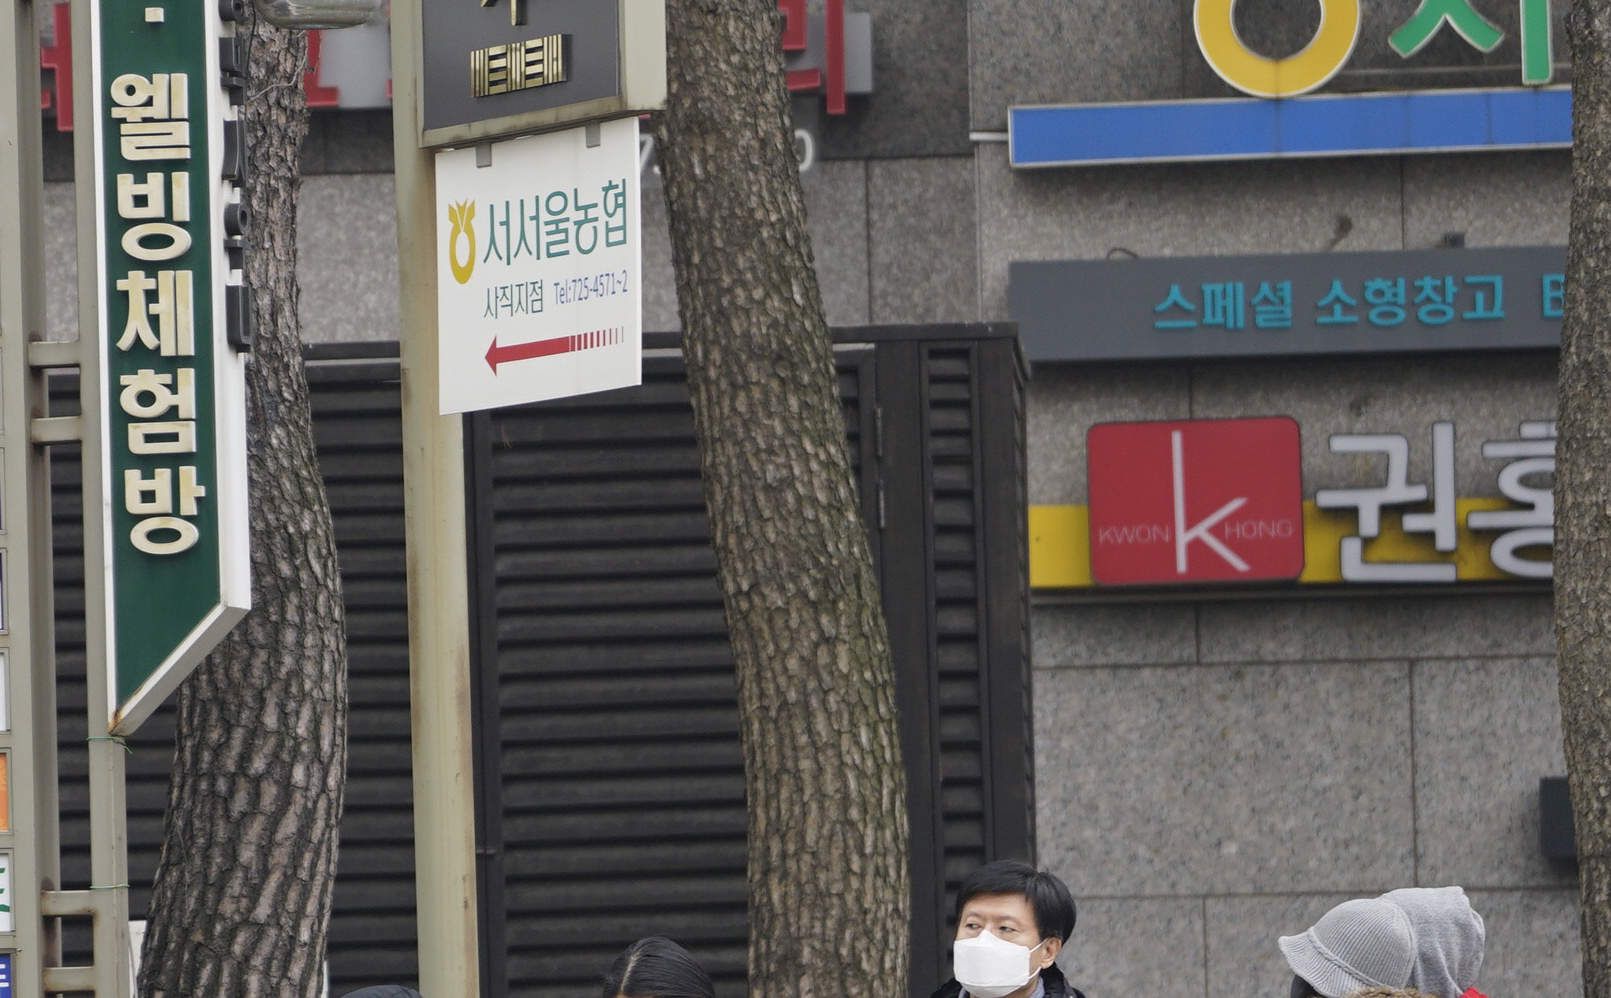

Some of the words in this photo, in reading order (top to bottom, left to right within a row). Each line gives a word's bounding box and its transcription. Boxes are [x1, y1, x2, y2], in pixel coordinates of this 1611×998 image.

[483, 178, 627, 266] 서서울농협
[109, 73, 207, 555] 웰빙체험방
[483, 279, 544, 319] 사직지점
[1153, 280, 1293, 330] 스페셜
[1316, 274, 1505, 326] 소형창고
[1099, 524, 1171, 545] KWON
[1225, 520, 1292, 540] HONG
